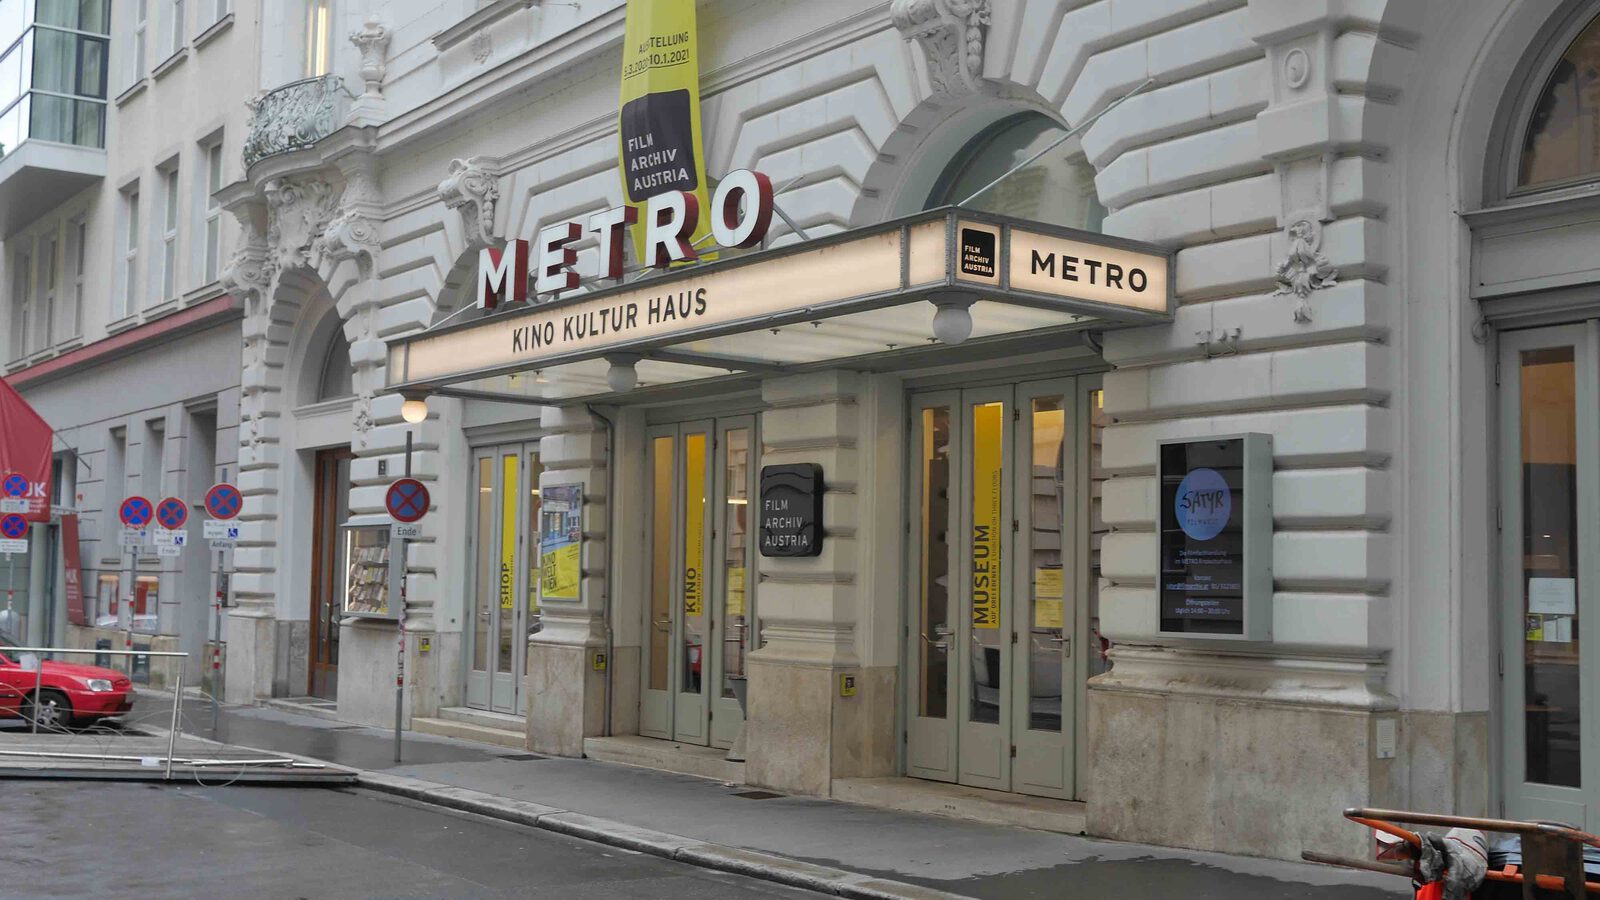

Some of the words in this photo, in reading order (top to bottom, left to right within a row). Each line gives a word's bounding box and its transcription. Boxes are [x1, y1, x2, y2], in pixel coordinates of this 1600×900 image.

[628, 132, 654, 152] FILM
[631, 148, 677, 171] ARCHIV
[634, 167, 689, 191] AUSTRIA
[477, 169, 773, 310] METRO
[964, 245, 981, 254] FILM
[964, 254, 990, 264] ARCHIV
[964, 262, 993, 273] AUSTRIA
[1031, 249, 1147, 293] METRO
[512, 321, 554, 353] KINO
[562, 301, 637, 342] KULTUR
[648, 287, 707, 325] HAUS
[765, 499, 789, 511] FILM
[1179, 490, 1224, 514] SATYR
[397, 526, 417, 536] Ende
[765, 516, 803, 529] ARCHIV
[764, 534, 809, 547] AUSTRIA
[500, 562, 510, 605] SHOP
[974, 525, 990, 624] MUSEUM
[686, 568, 696, 612] KINO
